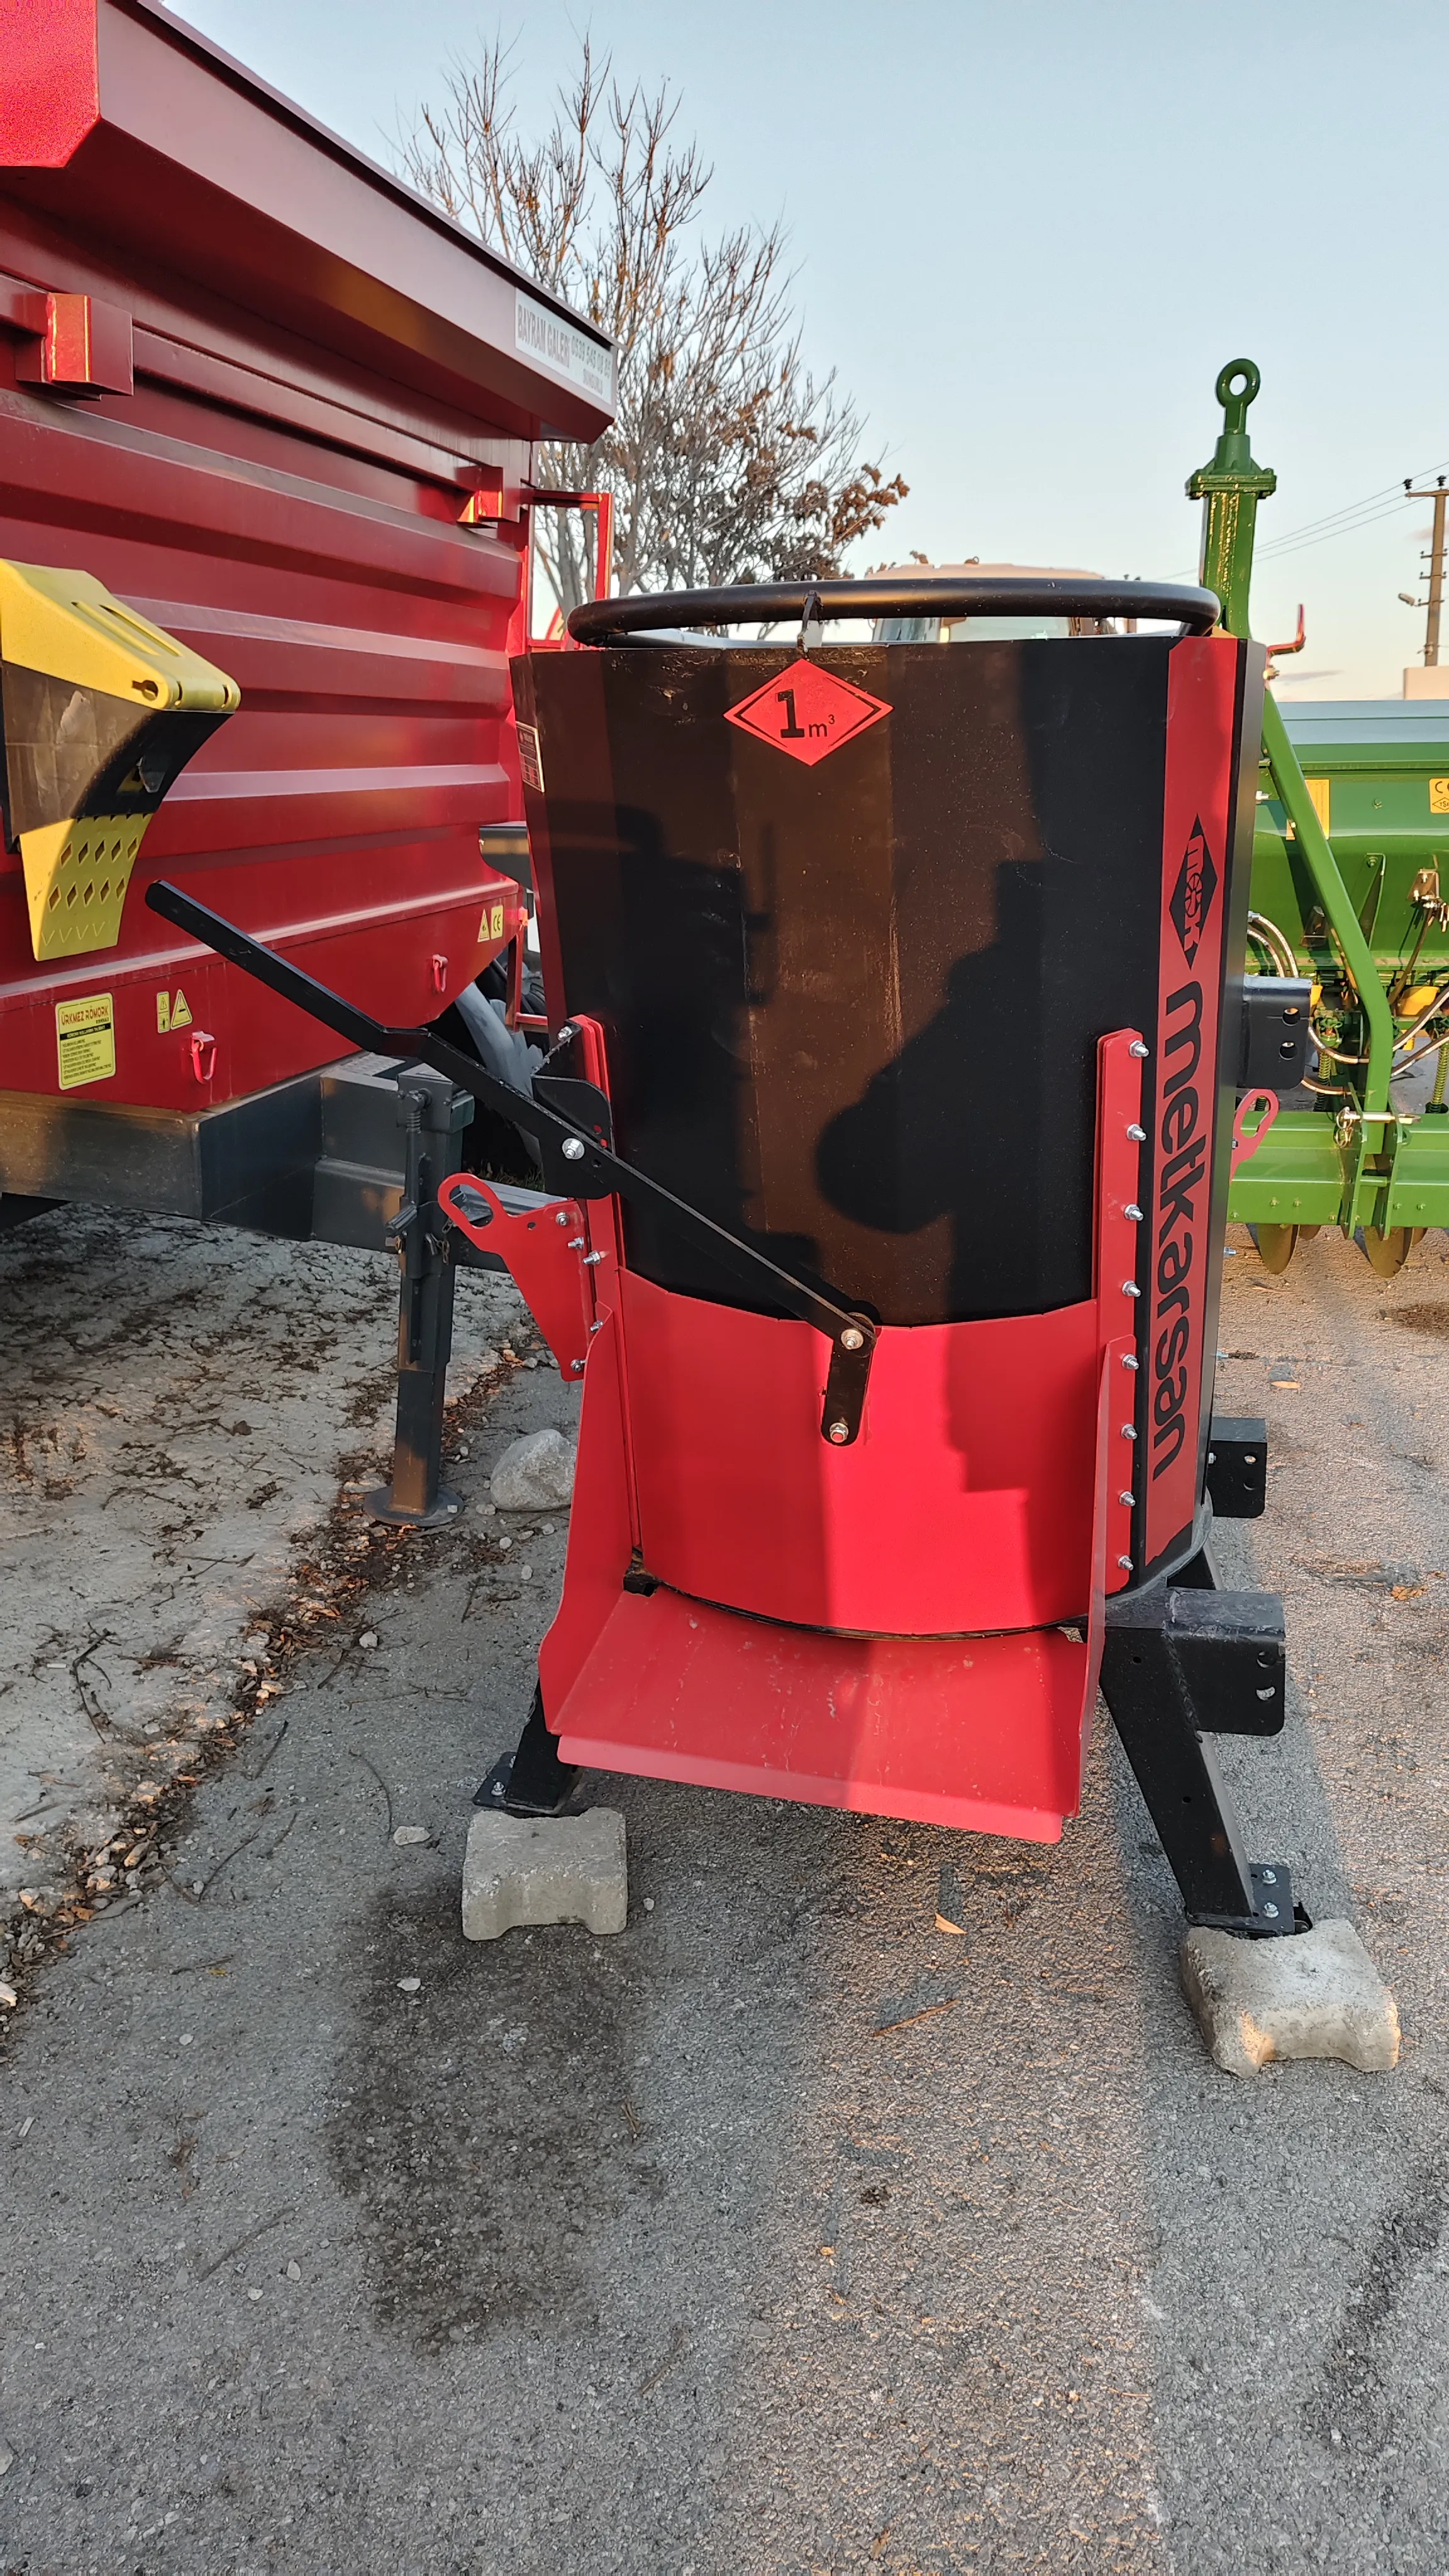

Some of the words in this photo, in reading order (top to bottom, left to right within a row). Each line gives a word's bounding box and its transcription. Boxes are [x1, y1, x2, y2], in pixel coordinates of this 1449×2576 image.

[518, 304, 546, 355] BAYRAM
[776, 689, 805, 738] 1
[493, 913, 501, 932] CE
[61, 1011, 85, 1026] ÜRKMEZ
[85, 1005, 109, 1021] RÖMORK
[1152, 980, 1206, 1482] metkarsan
